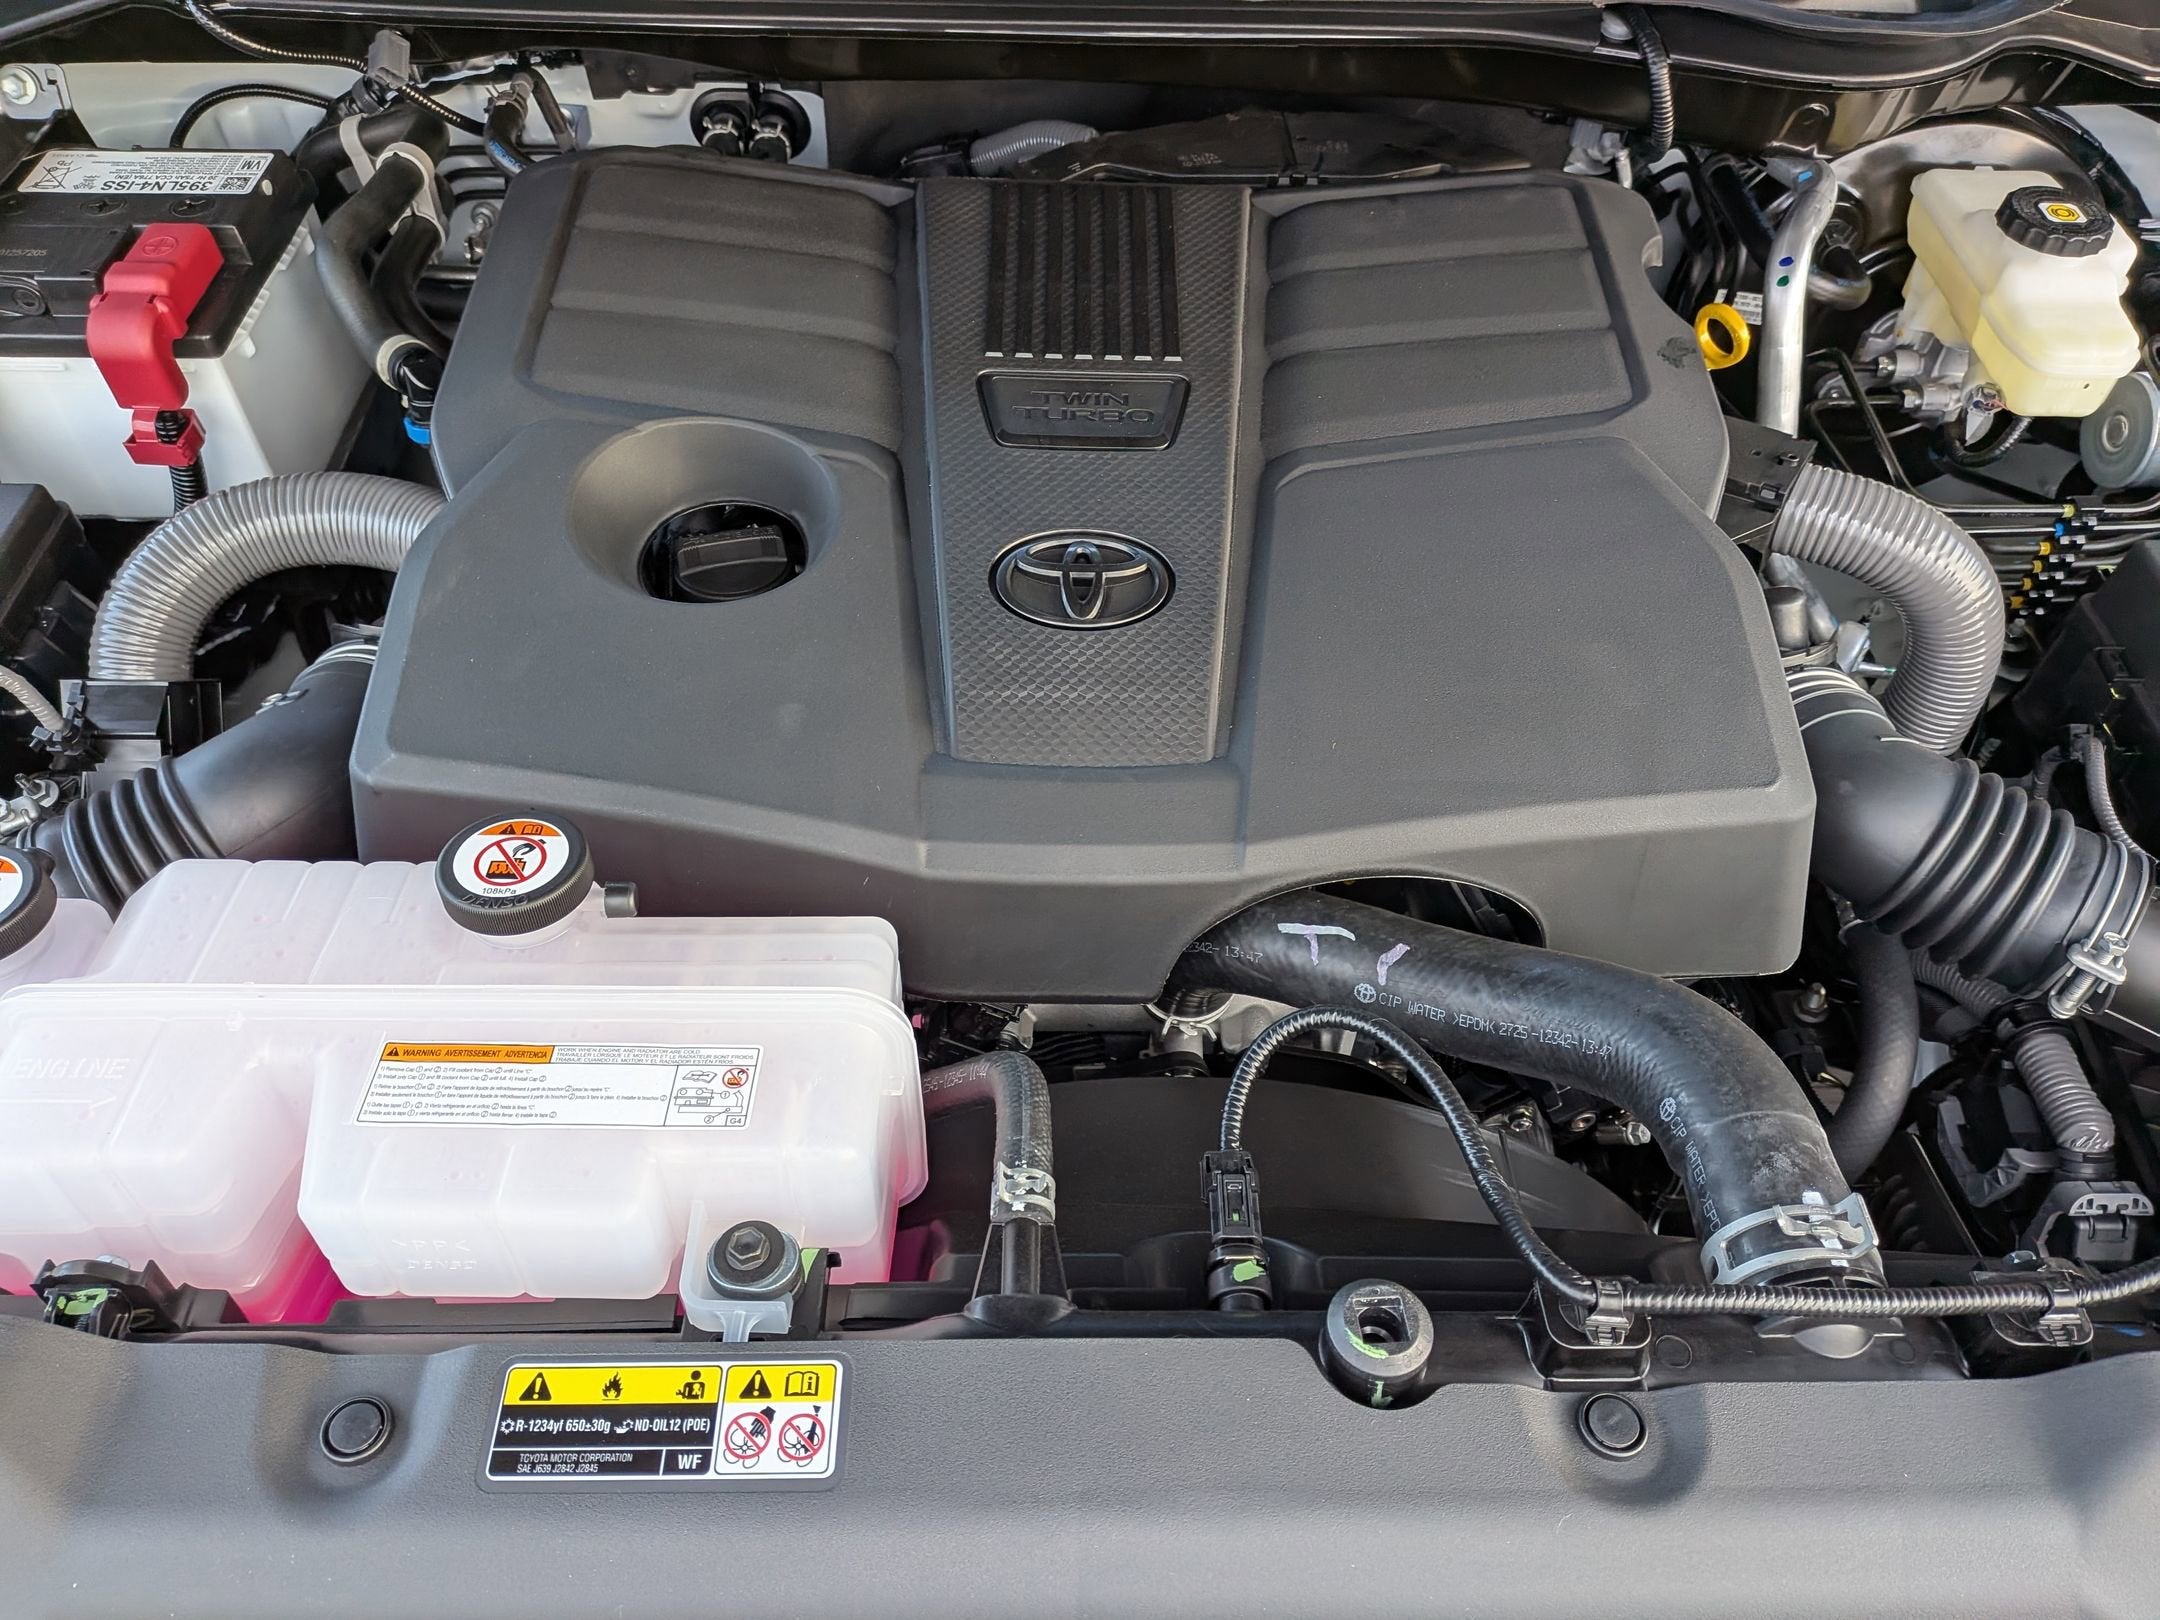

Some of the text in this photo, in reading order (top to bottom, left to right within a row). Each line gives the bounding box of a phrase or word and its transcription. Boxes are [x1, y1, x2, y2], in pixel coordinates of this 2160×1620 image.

[241, 160, 261, 169] VM
[100, 181, 213, 191] 395LN4-ISS
[1030, 390, 1129, 406] TWIN
[1012, 405, 1155, 423] TURBO
[481, 886, 518, 895] 108kPa
[460, 893, 530, 909] DENSO
[1225, 945, 1264, 963] 13:47
[1378, 991, 1402, 1008] CIP
[1407, 1000, 1446, 1023] WATER
[1498, 1022, 1528, 1039] 2725
[1581, 1038, 1613, 1060] 13:47
[402, 1048, 547, 1059] WARNING AVERTISSEMENT ADVERTENCIA
[8, 1058, 130, 1079] ENGINE
[1670, 1116, 1688, 1138] CIP
[1684, 1140, 1707, 1185] WATER
[407, 1259, 477, 1271] DENSO
[515, 1418, 711, 1435] R-1234yf 650±30g ND-OIL12 (POE)
[519, 1452, 633, 1463] TOYOTA MOTOR CORPORATION
[677, 1454, 703, 1470] WF
[516, 1463, 599, 1473] SAE J639 J2842 J2845
